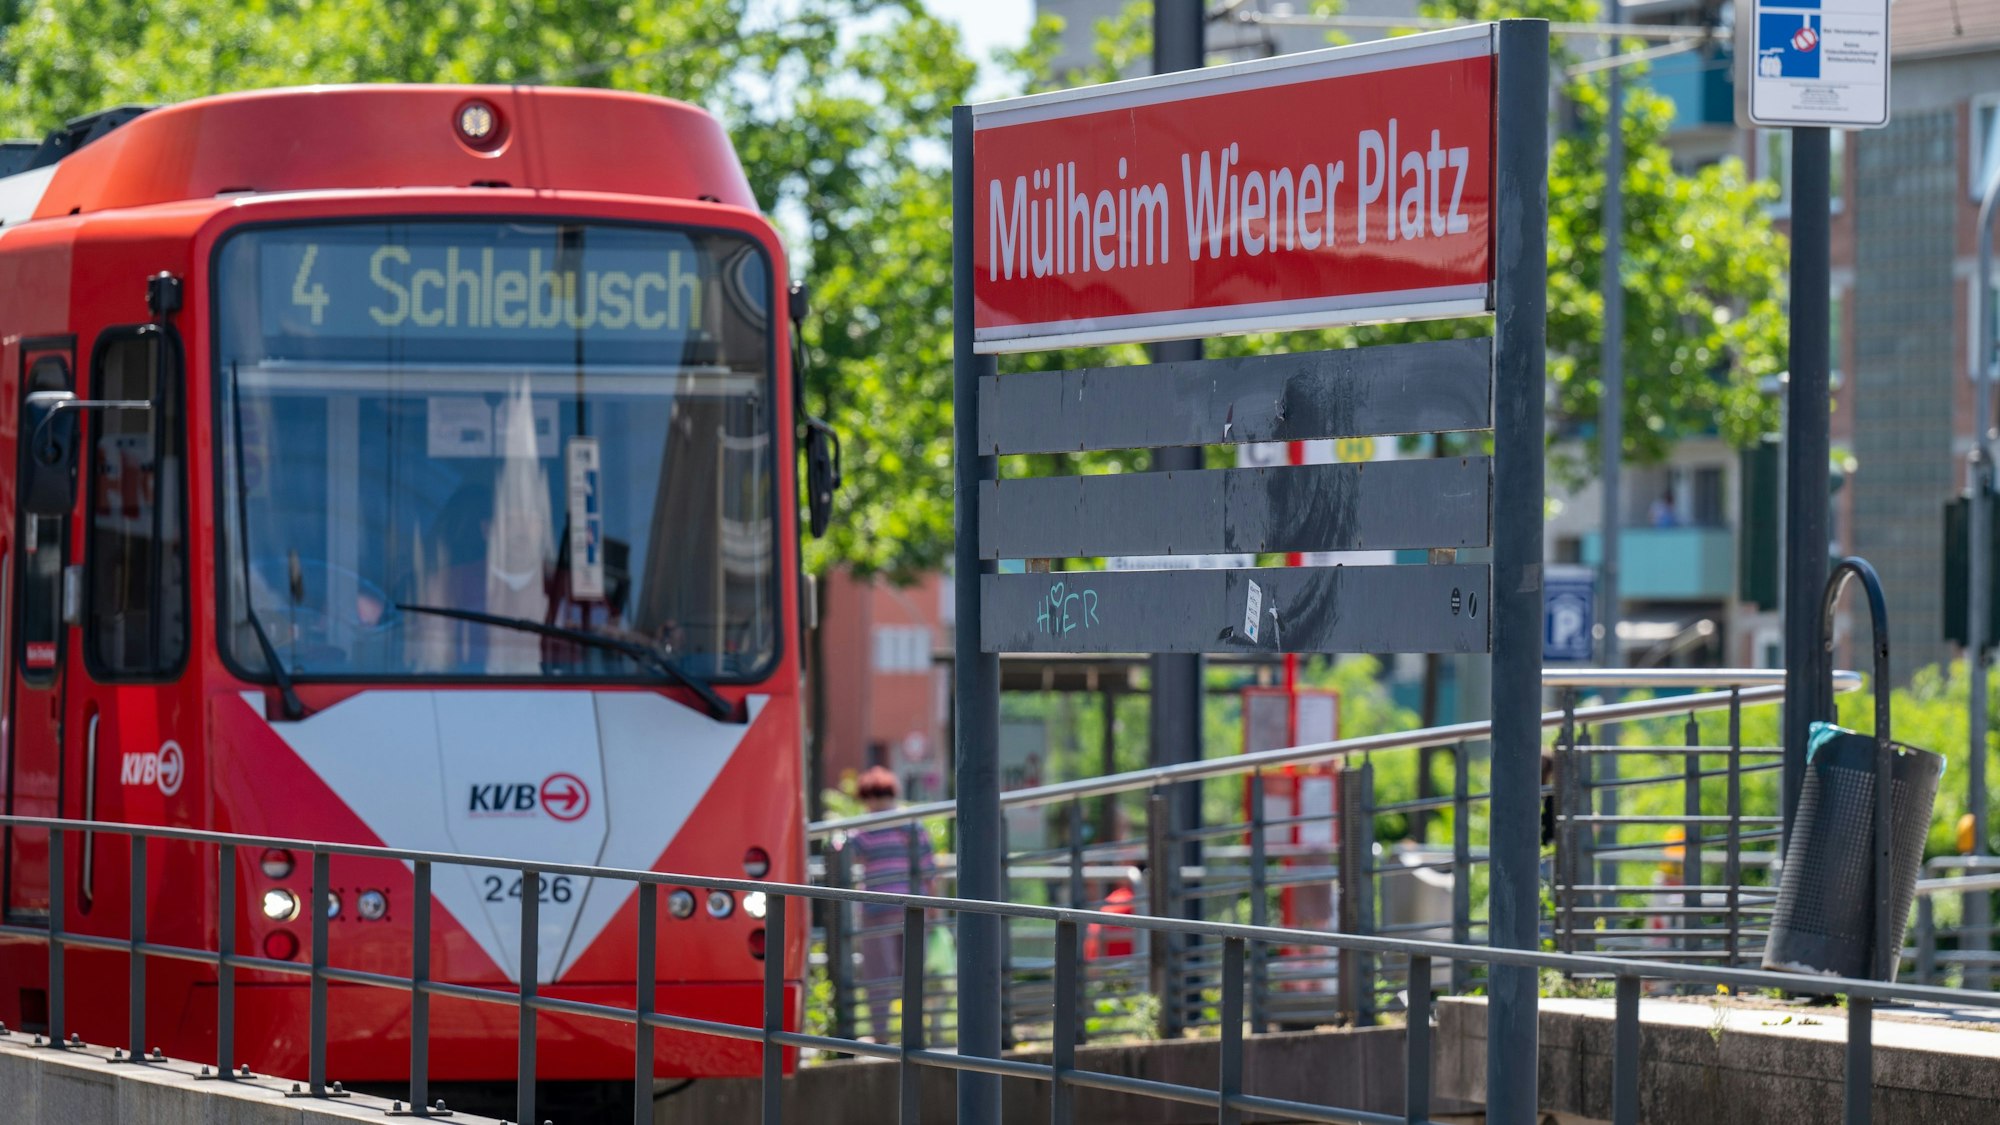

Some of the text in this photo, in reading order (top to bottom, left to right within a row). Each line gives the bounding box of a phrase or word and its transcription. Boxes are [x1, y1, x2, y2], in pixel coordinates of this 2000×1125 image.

[989, 117, 1470, 282] Mülheim Wiener Platz
[292, 244, 702, 331] 4 Schlebusch
[120, 752, 158, 786] KVB
[469, 782, 537, 812] KVB
